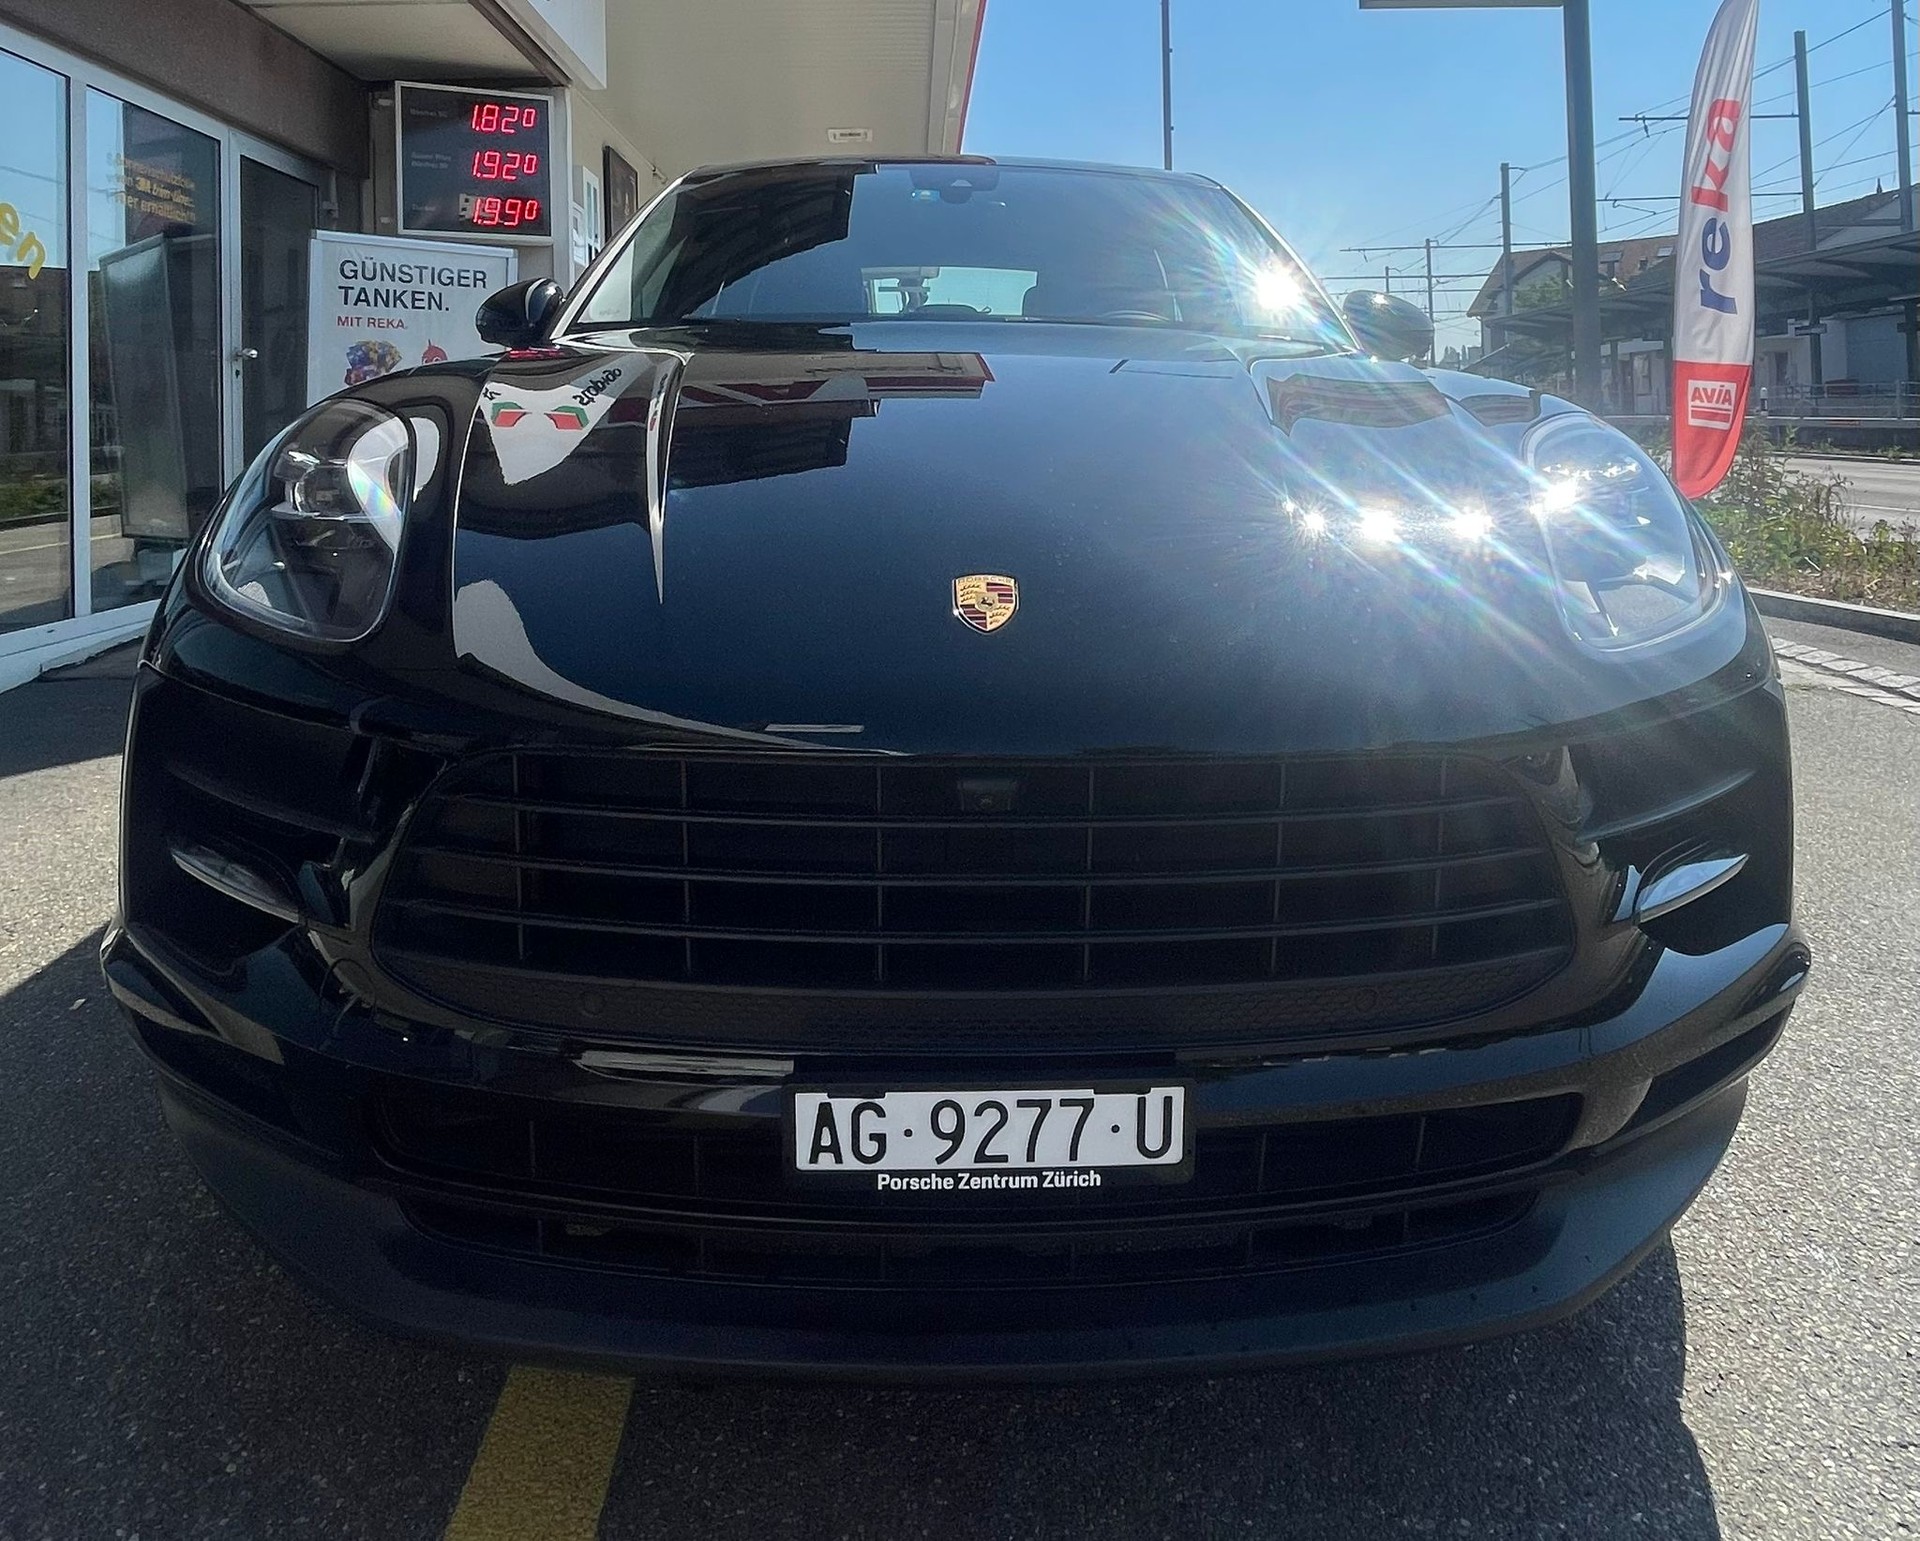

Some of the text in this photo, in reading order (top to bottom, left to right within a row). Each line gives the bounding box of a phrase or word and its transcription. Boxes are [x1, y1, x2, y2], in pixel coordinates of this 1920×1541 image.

[1691, 98, 1740, 315] reka
[339, 257, 487, 289] GÜNSTIGER
[338, 286, 450, 311] TANKEN.
[337, 315, 362, 327] MIT
[1691, 385, 1733, 406] AVIA
[877, 1170, 1101, 1190] Porsche Zentrum Zürich
